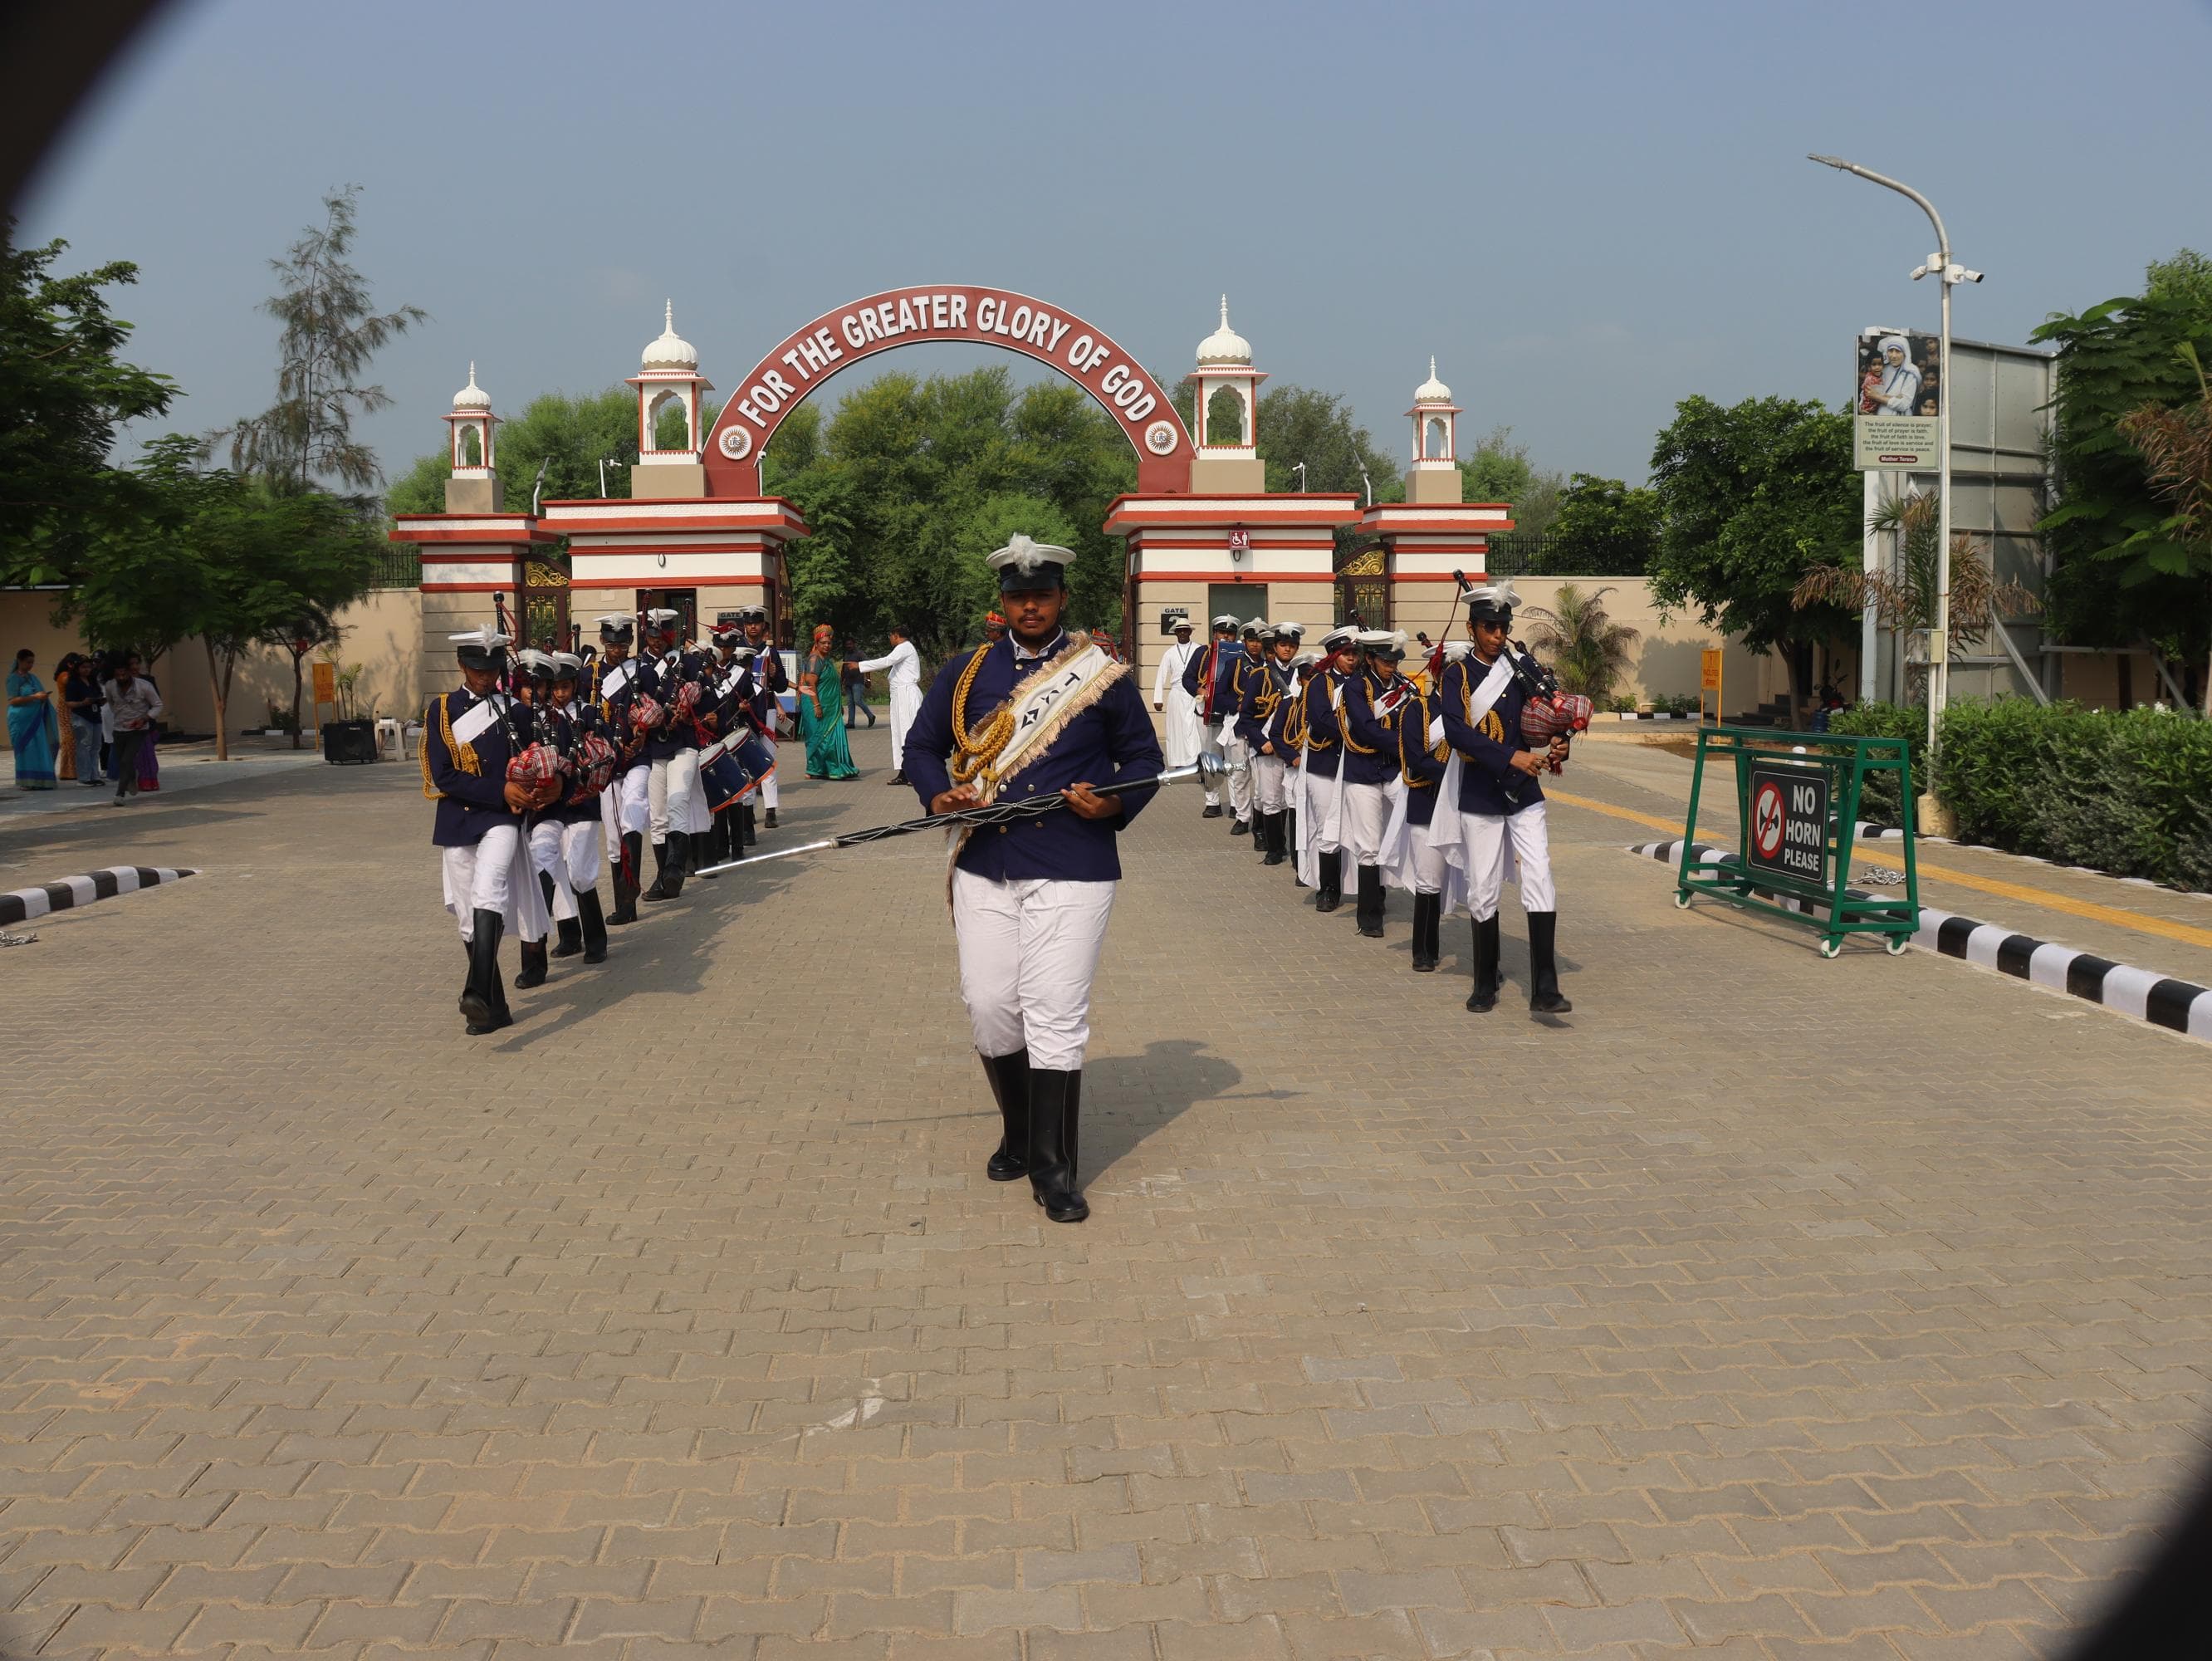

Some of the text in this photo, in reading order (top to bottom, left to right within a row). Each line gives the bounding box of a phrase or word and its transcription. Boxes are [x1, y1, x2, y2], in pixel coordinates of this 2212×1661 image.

[737, 294, 1157, 429] FOR THE GREATER GLORY OF GOD
[1793, 784, 1816, 815] NO
[1786, 819, 1821, 847] HORN
[1784, 848, 1819, 871] PLEASE
